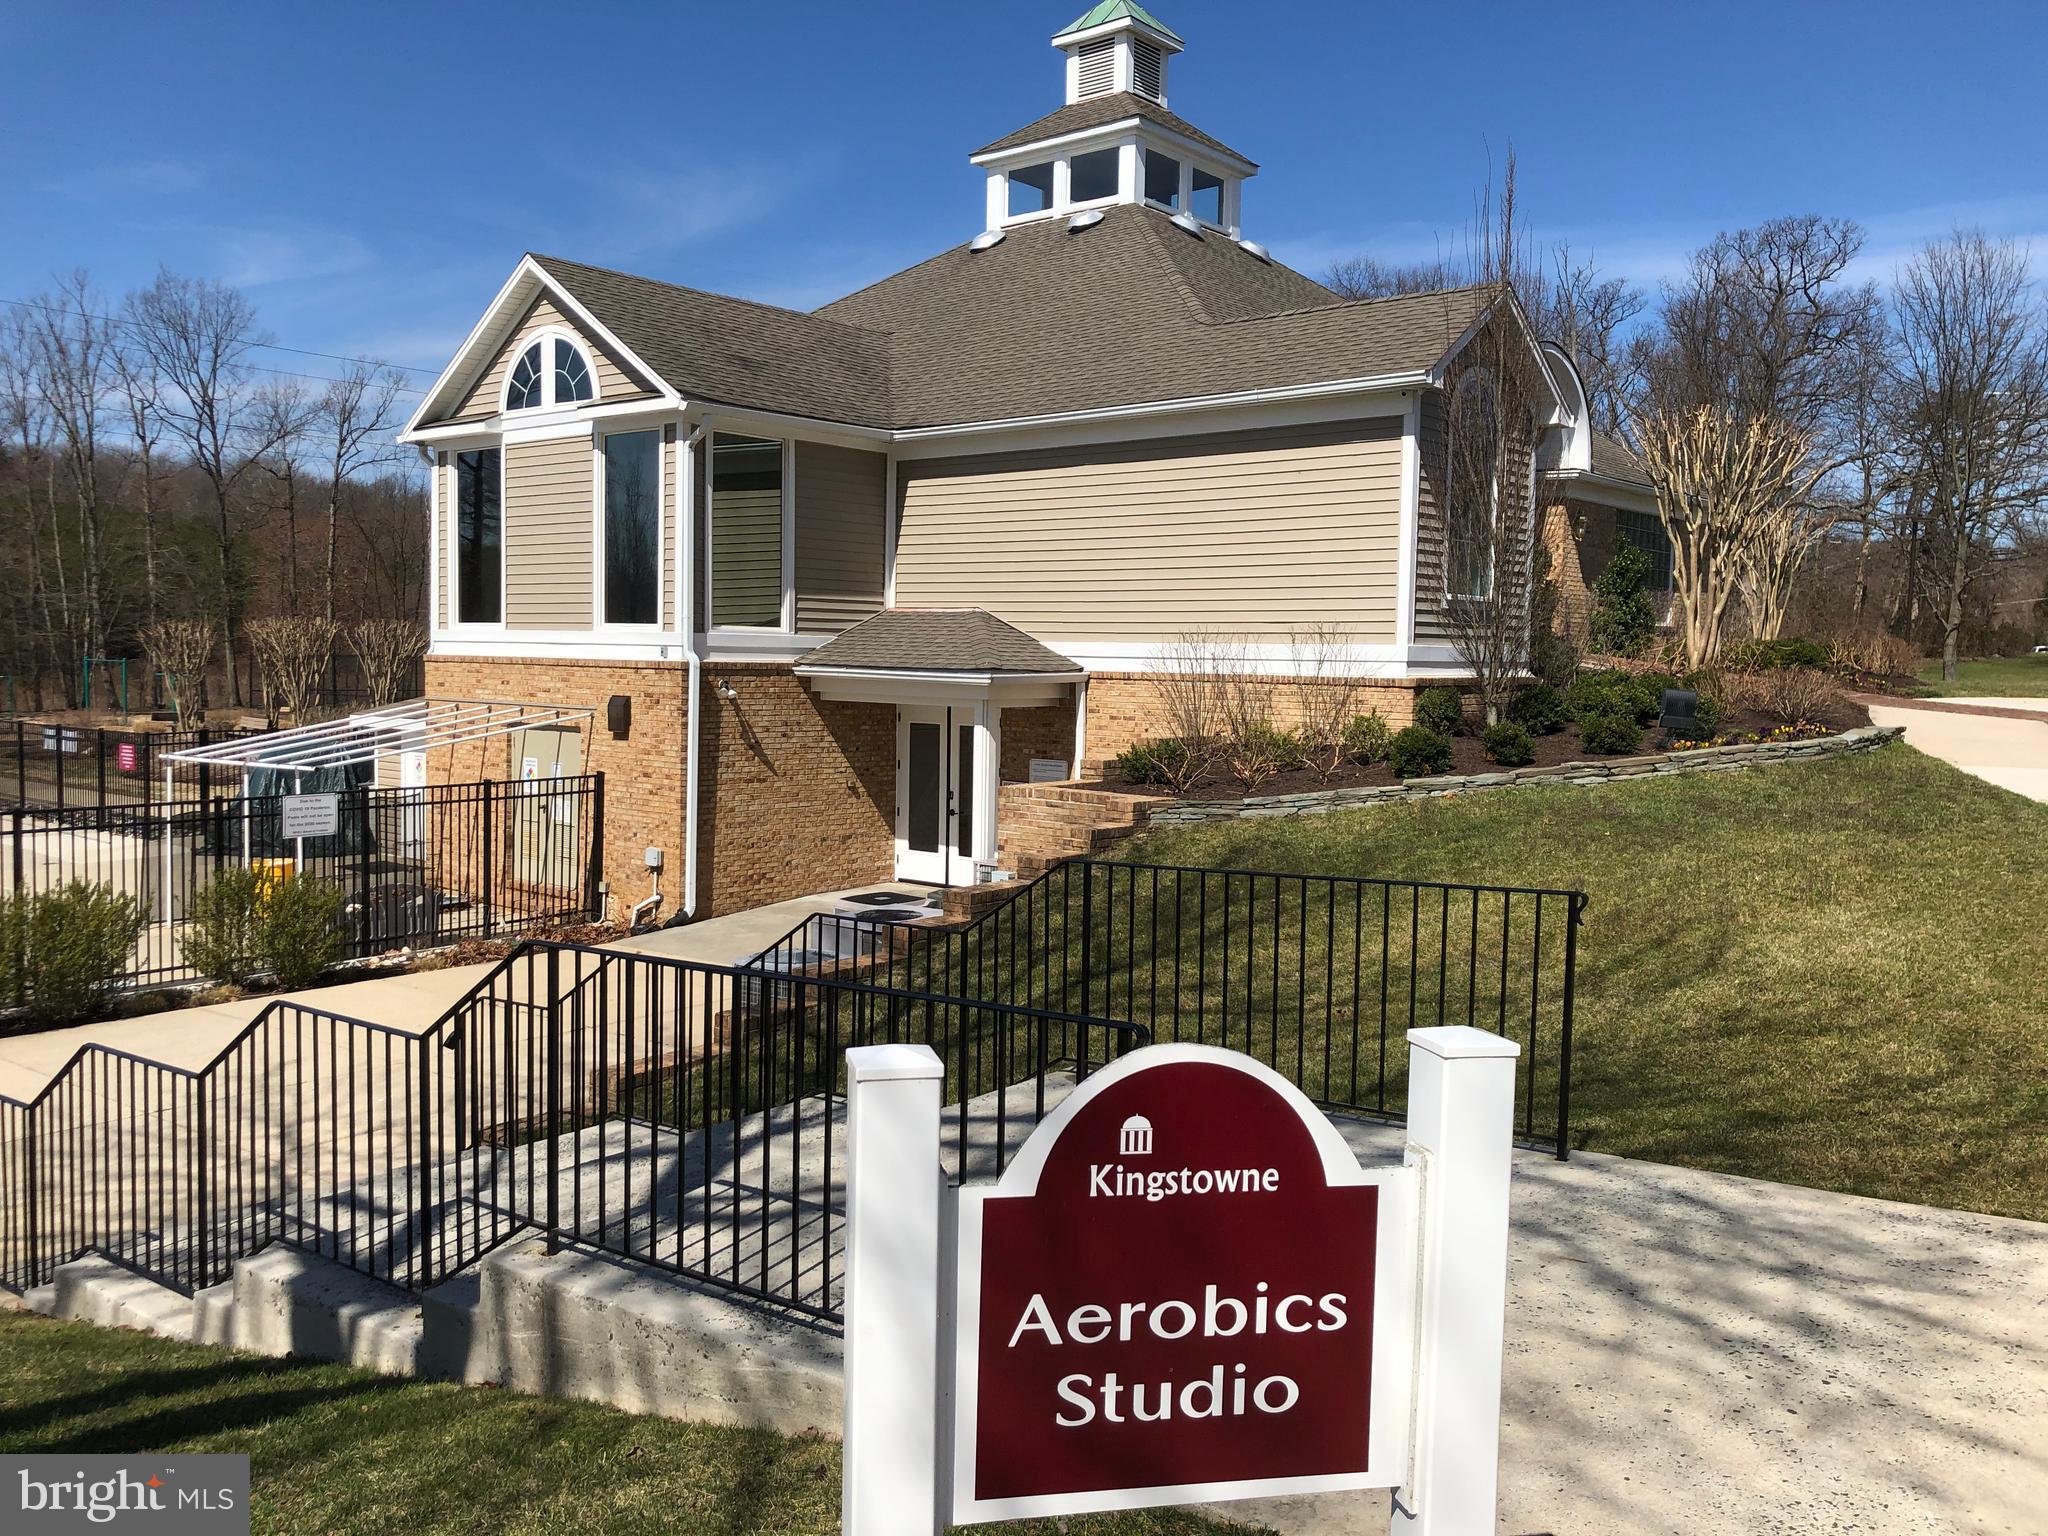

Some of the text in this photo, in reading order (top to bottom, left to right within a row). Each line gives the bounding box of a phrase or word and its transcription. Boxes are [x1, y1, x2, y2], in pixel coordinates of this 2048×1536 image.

[1090, 1164, 1279, 1201] Kingstowne
[1008, 1282, 1348, 1348] Aerobics
[1056, 1363, 1300, 1427] Studio
